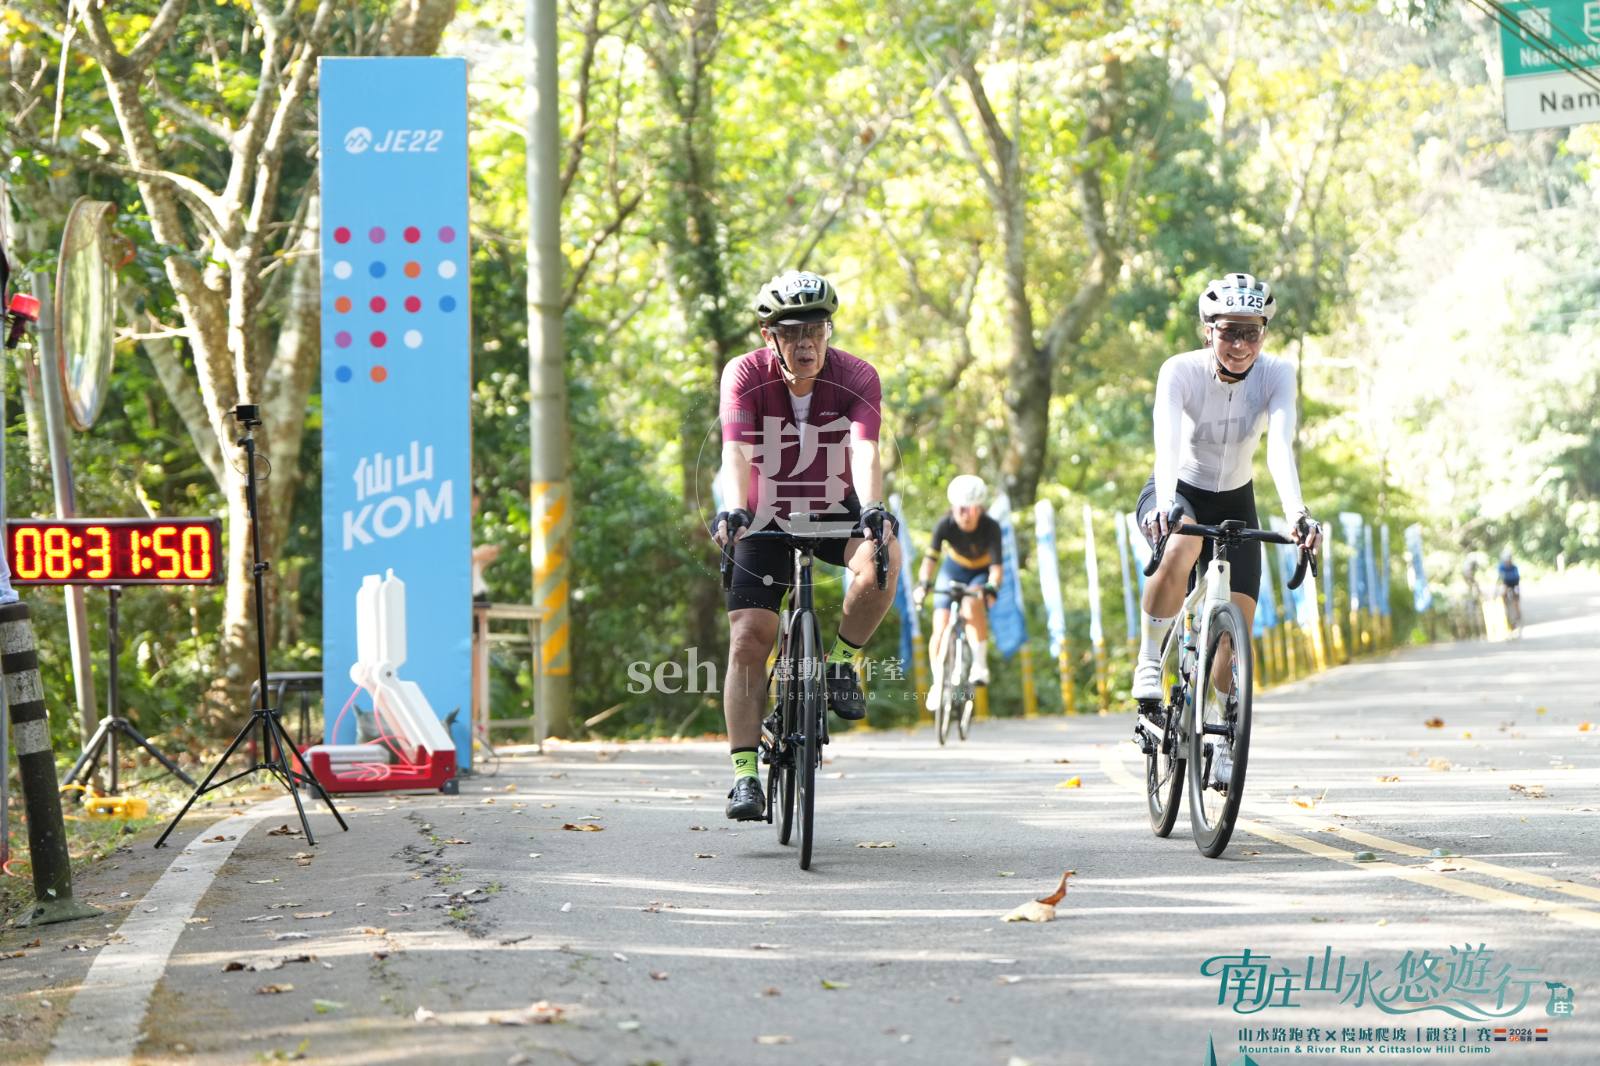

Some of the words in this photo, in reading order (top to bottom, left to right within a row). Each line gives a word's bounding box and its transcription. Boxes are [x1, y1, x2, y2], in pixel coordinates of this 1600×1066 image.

[374, 129, 444, 152] JE22
[352, 440, 433, 501] 仙山
[342, 479, 453, 551] KOM
[15, 527, 211, 578] 08:31:50
